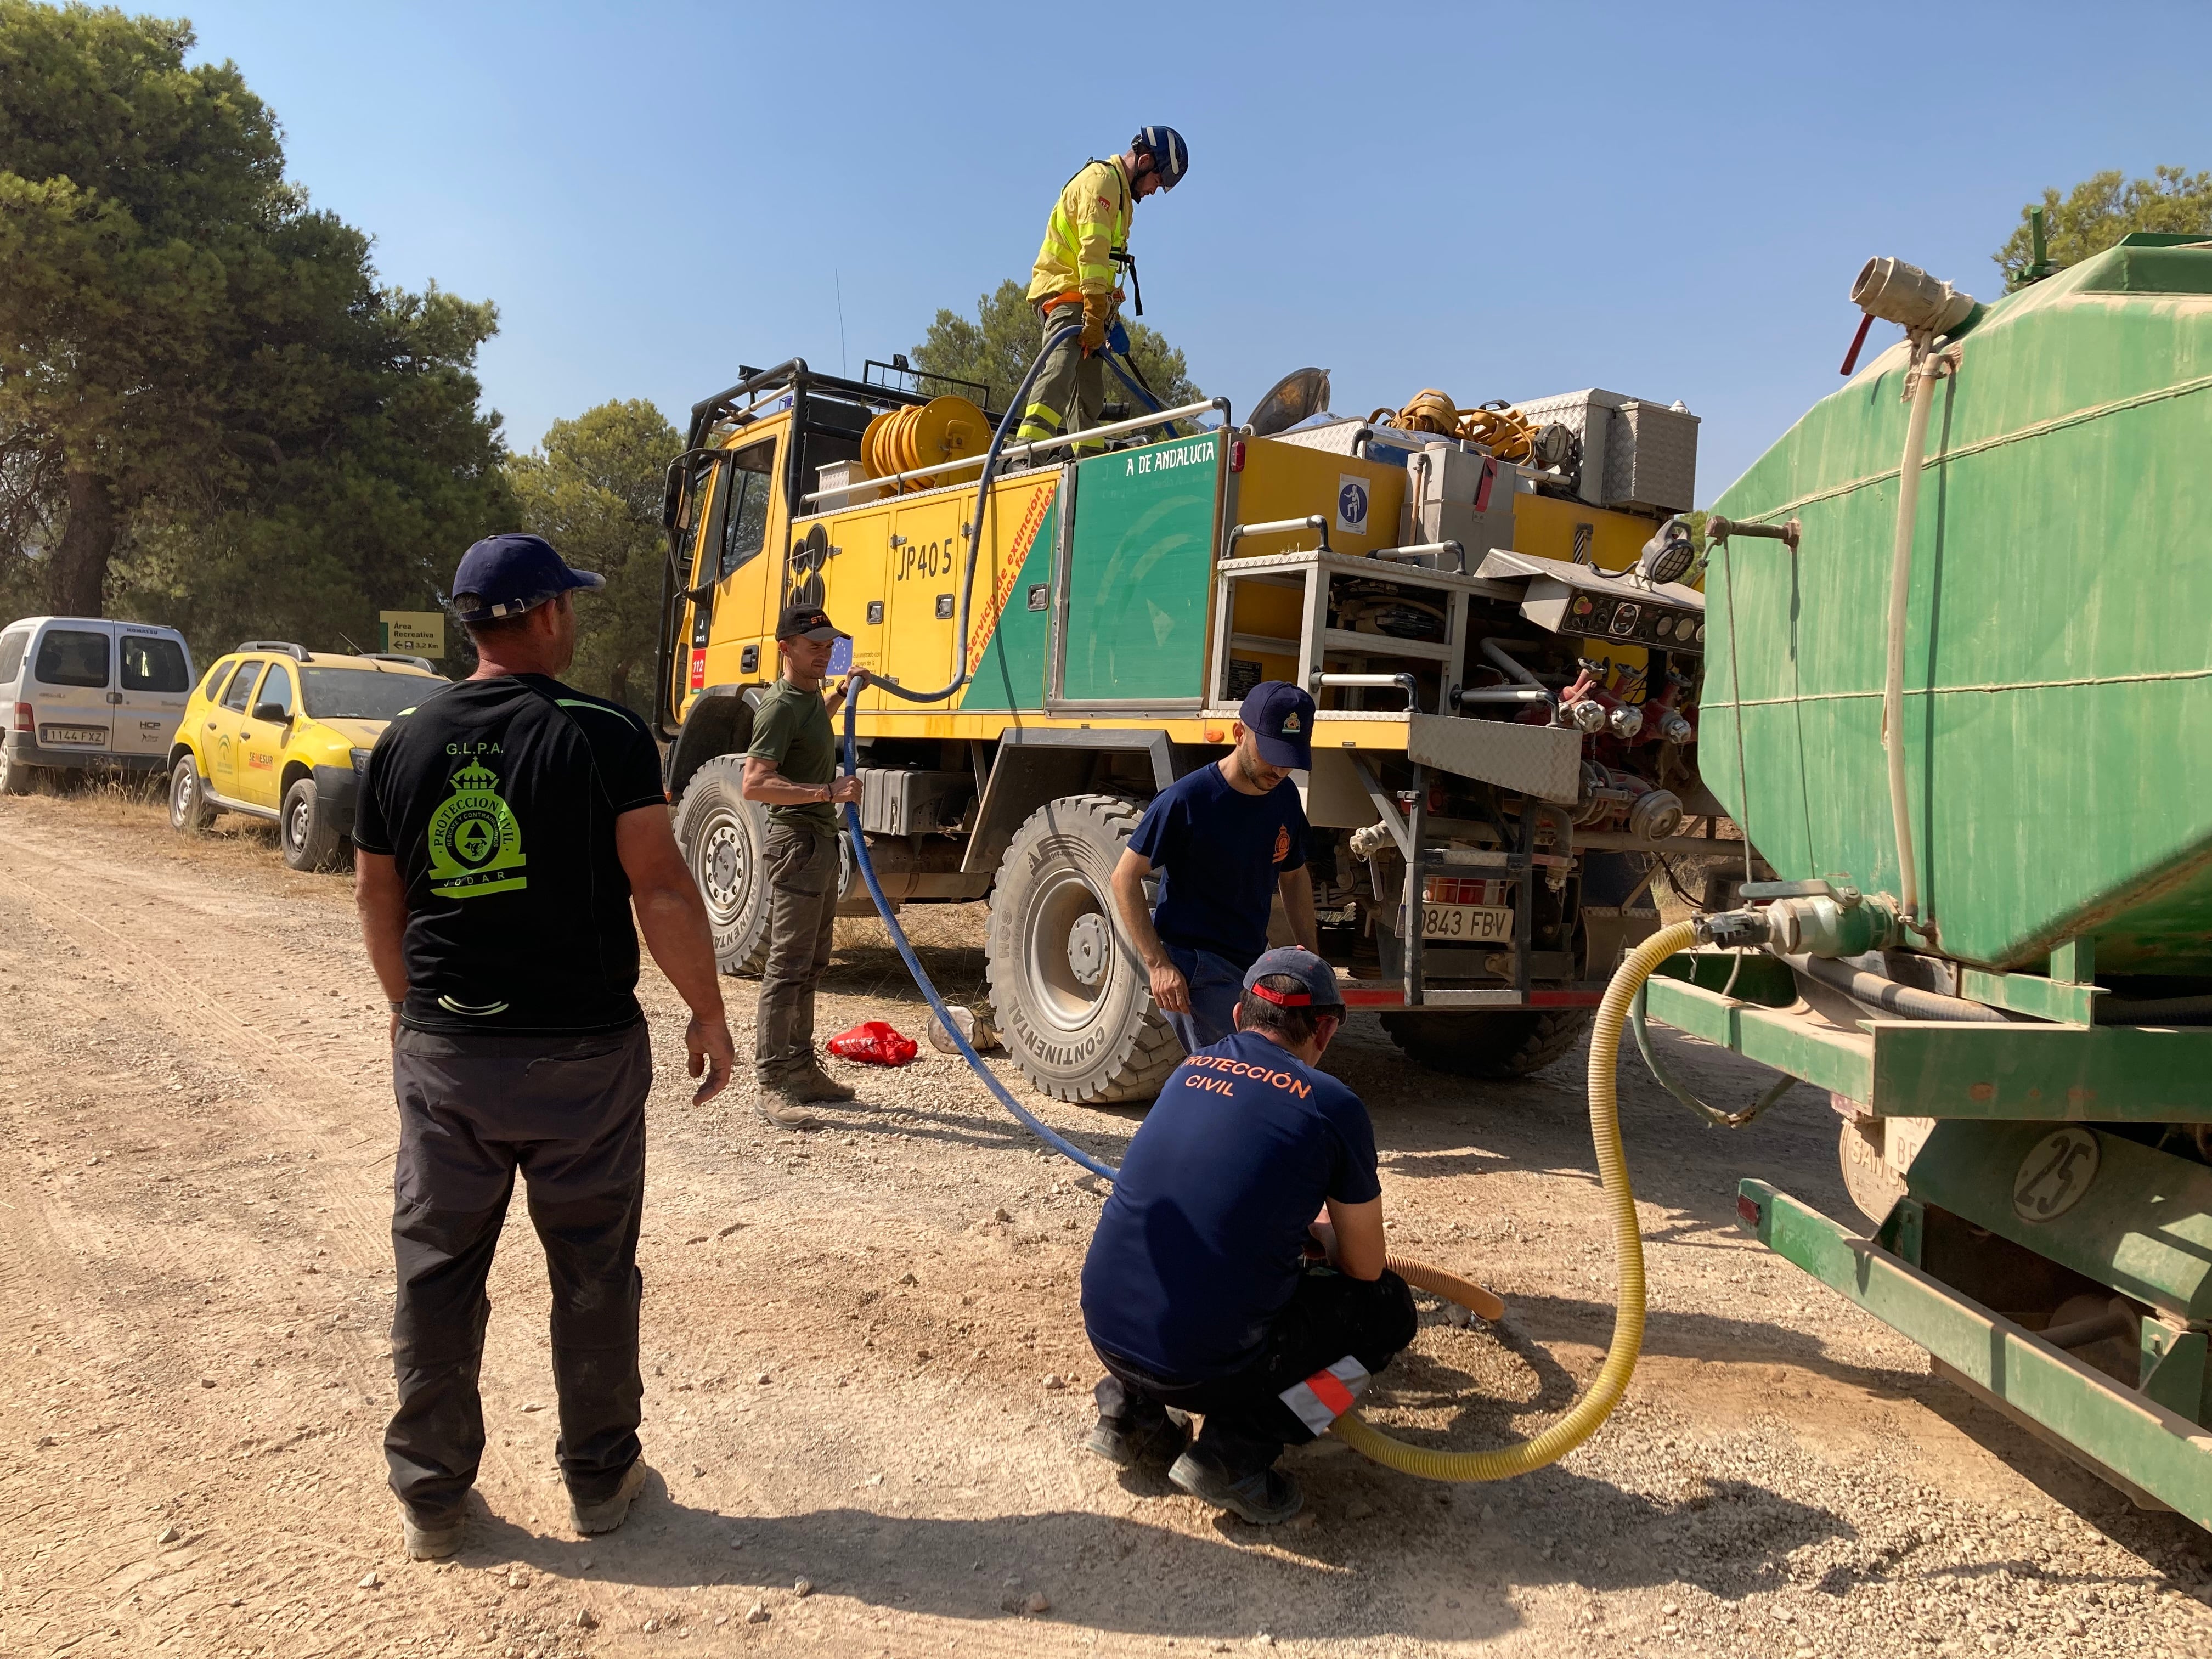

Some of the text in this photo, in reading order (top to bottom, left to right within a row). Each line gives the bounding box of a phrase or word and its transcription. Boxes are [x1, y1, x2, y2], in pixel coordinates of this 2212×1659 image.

[1099, 200, 1109, 209] 112
[1138, 454, 1152, 474] DE
[1154, 442, 1214, 471] ANDALUCIA
[967, 487, 1042, 656] Servicio de extinción
[970, 486, 1054, 674] de incendios forestales
[394, 620, 412, 629] Área
[693, 659, 704, 673] 112
[51, 730, 102, 742] 1144 FXZ
[446, 742, 504, 755] G.L.P.A.
[434, 797, 514, 847] PROTECCION CIVIL
[447, 820, 460, 847] RESCATE
[1051, 851, 1075, 860] OFF-ROAD
[444, 871, 505, 887] JODAR
[712, 859, 759, 949] CONTINENTA
[999, 910, 1013, 959] HCS
[1470, 911, 1506, 937] FBV
[1008, 996, 1105, 1066] CONTINENTAL
[1181, 1055, 1311, 1099] PROTECCIÓN
[1185, 1075, 1233, 1097] CIVIL
[2015, 1135, 2093, 1215] 25
